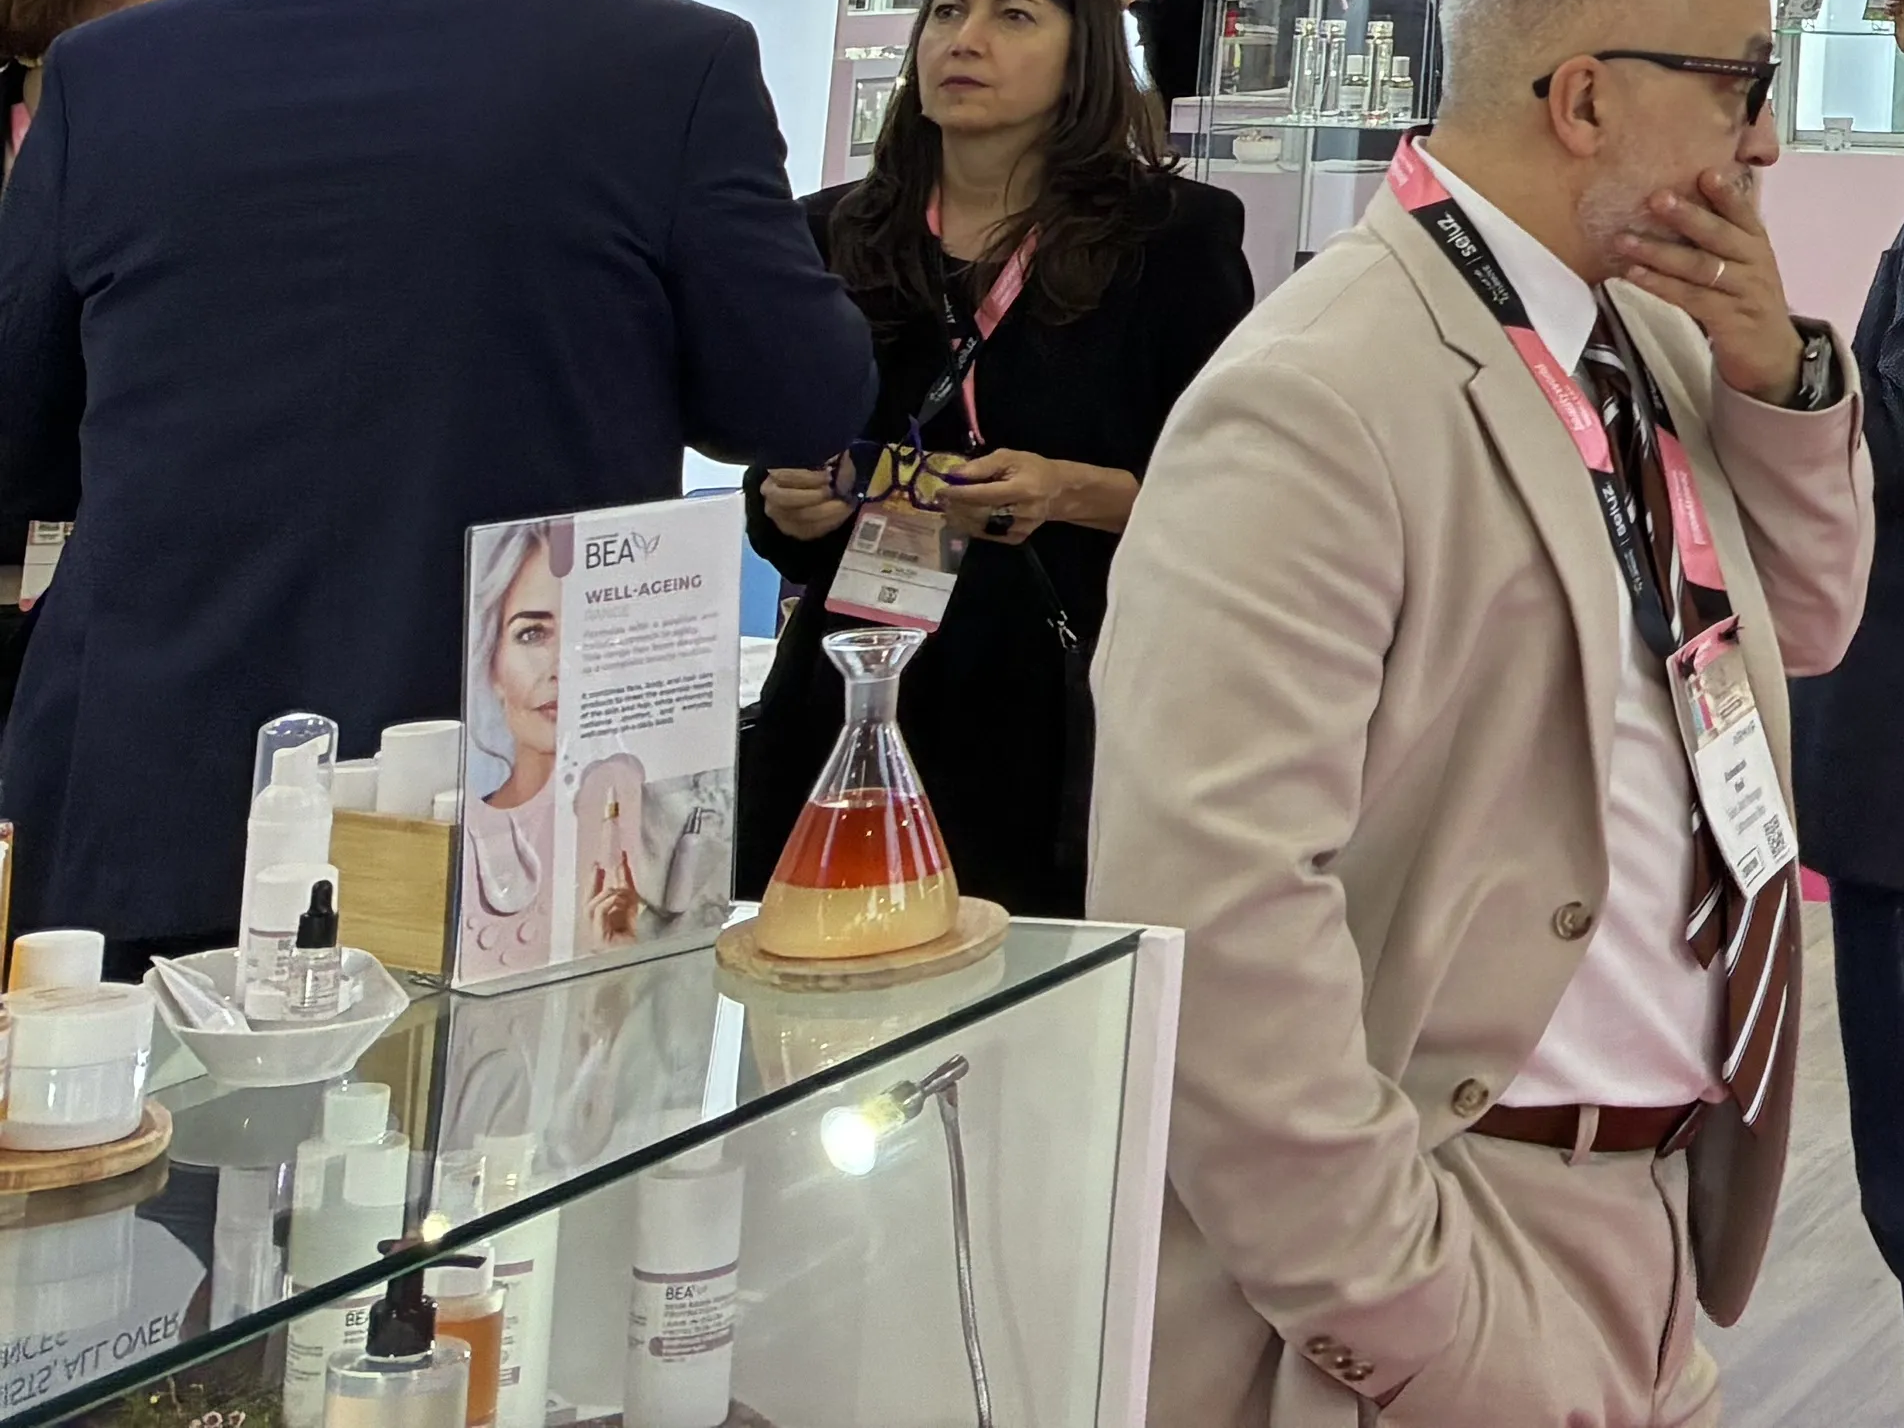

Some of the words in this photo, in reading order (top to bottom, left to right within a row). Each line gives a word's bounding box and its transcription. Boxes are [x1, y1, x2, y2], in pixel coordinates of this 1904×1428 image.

[586, 537, 635, 569] BEA
[585, 574, 702, 604] WELL-AGEING
[665, 1286, 693, 1300] BEA
